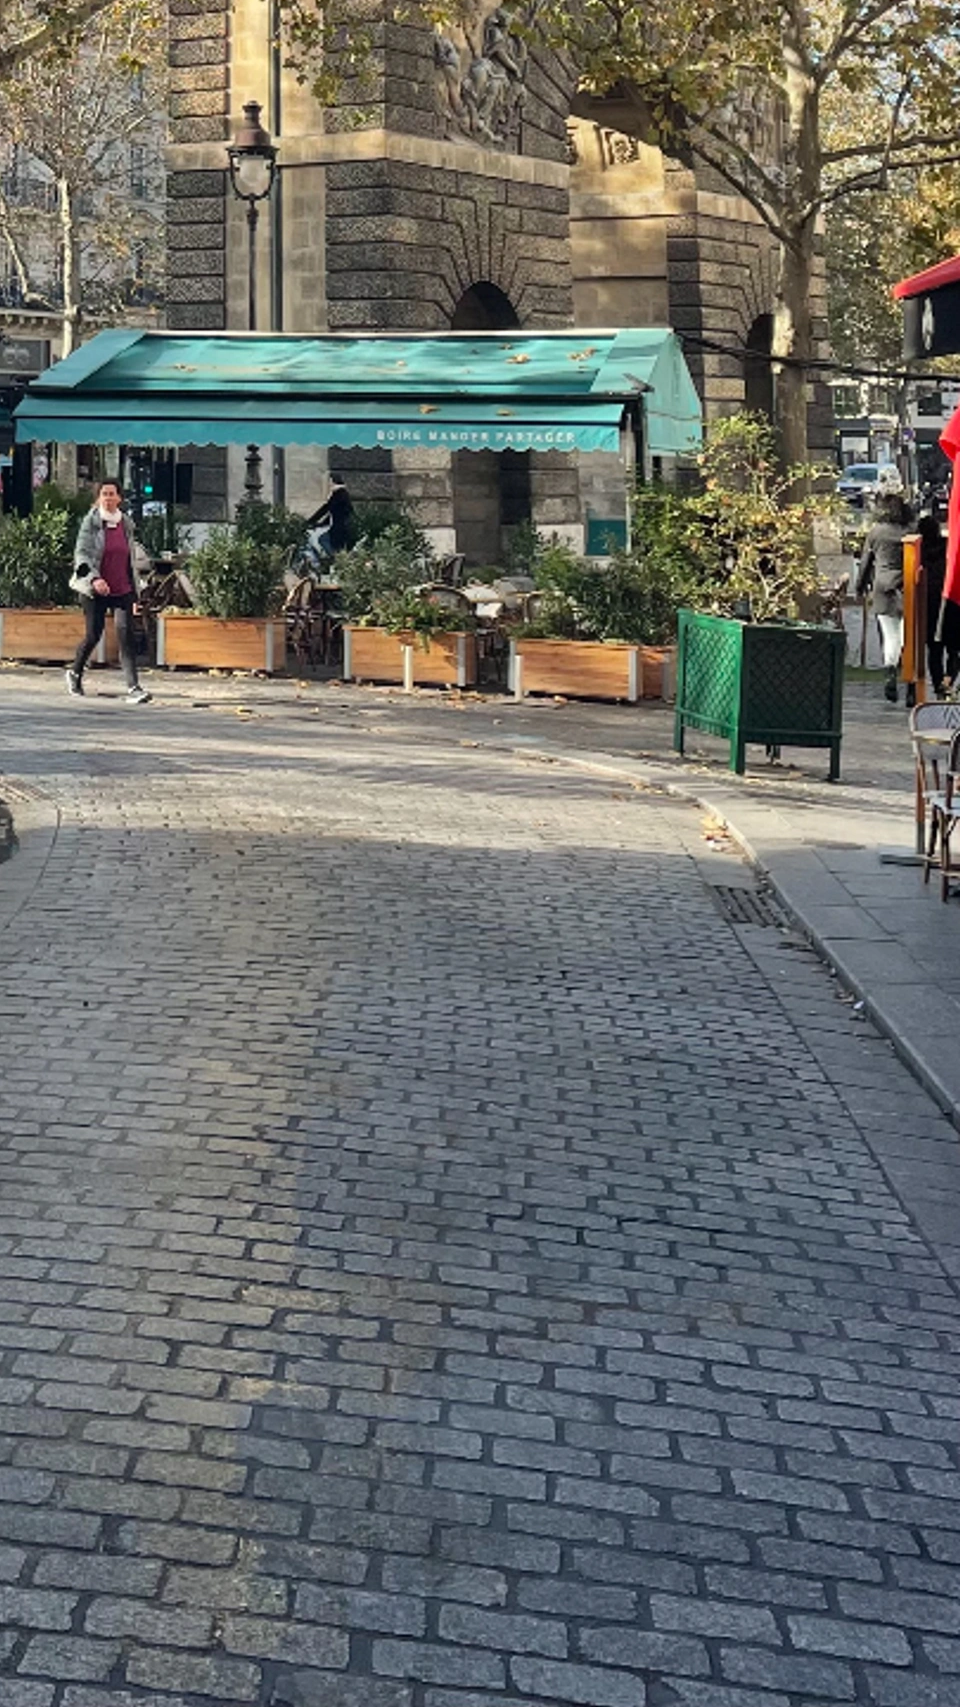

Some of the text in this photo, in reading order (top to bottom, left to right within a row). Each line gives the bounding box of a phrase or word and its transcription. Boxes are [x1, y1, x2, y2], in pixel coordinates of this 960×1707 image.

[376, 429, 576, 443] BOIRE MANGER PARTAGER
